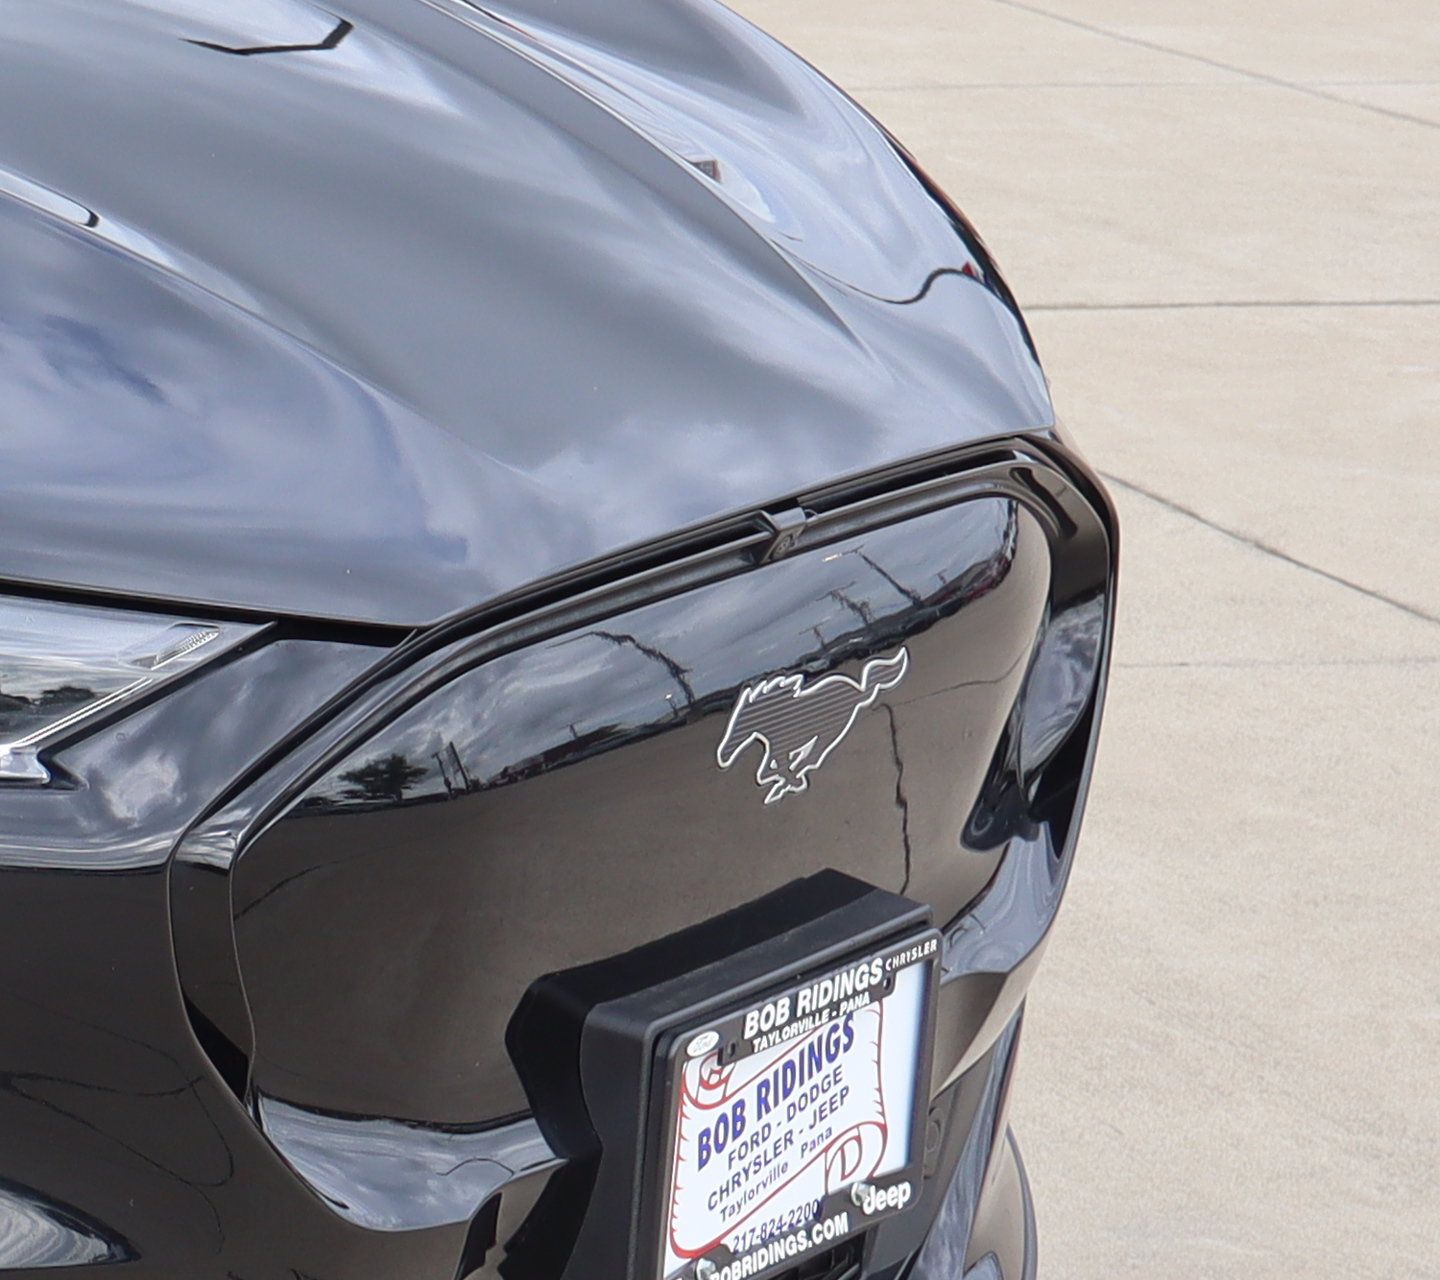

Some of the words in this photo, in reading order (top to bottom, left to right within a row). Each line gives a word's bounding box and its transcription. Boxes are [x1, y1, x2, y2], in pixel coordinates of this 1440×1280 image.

[743, 996, 790, 1040] BOB
[796, 957, 883, 1019] RIDINGS
[885, 938, 938, 971] CHRYSLER
[751, 1009, 830, 1053] TAYLORVILLE
[838, 991, 871, 1018] PANA
[697, 1097, 747, 1172] BOB
[756, 1011, 855, 1121] RIDINGS
[728, 1121, 772, 1171] FORD
[786, 1064, 843, 1122] DODGE
[707, 1128, 795, 1211] CHRYSLER
[809, 1085, 850, 1131] JEEP
[720, 1161, 789, 1223] Taylorville
[800, 1126, 833, 1159] Pana
[862, 1181, 912, 1215] Jeep
